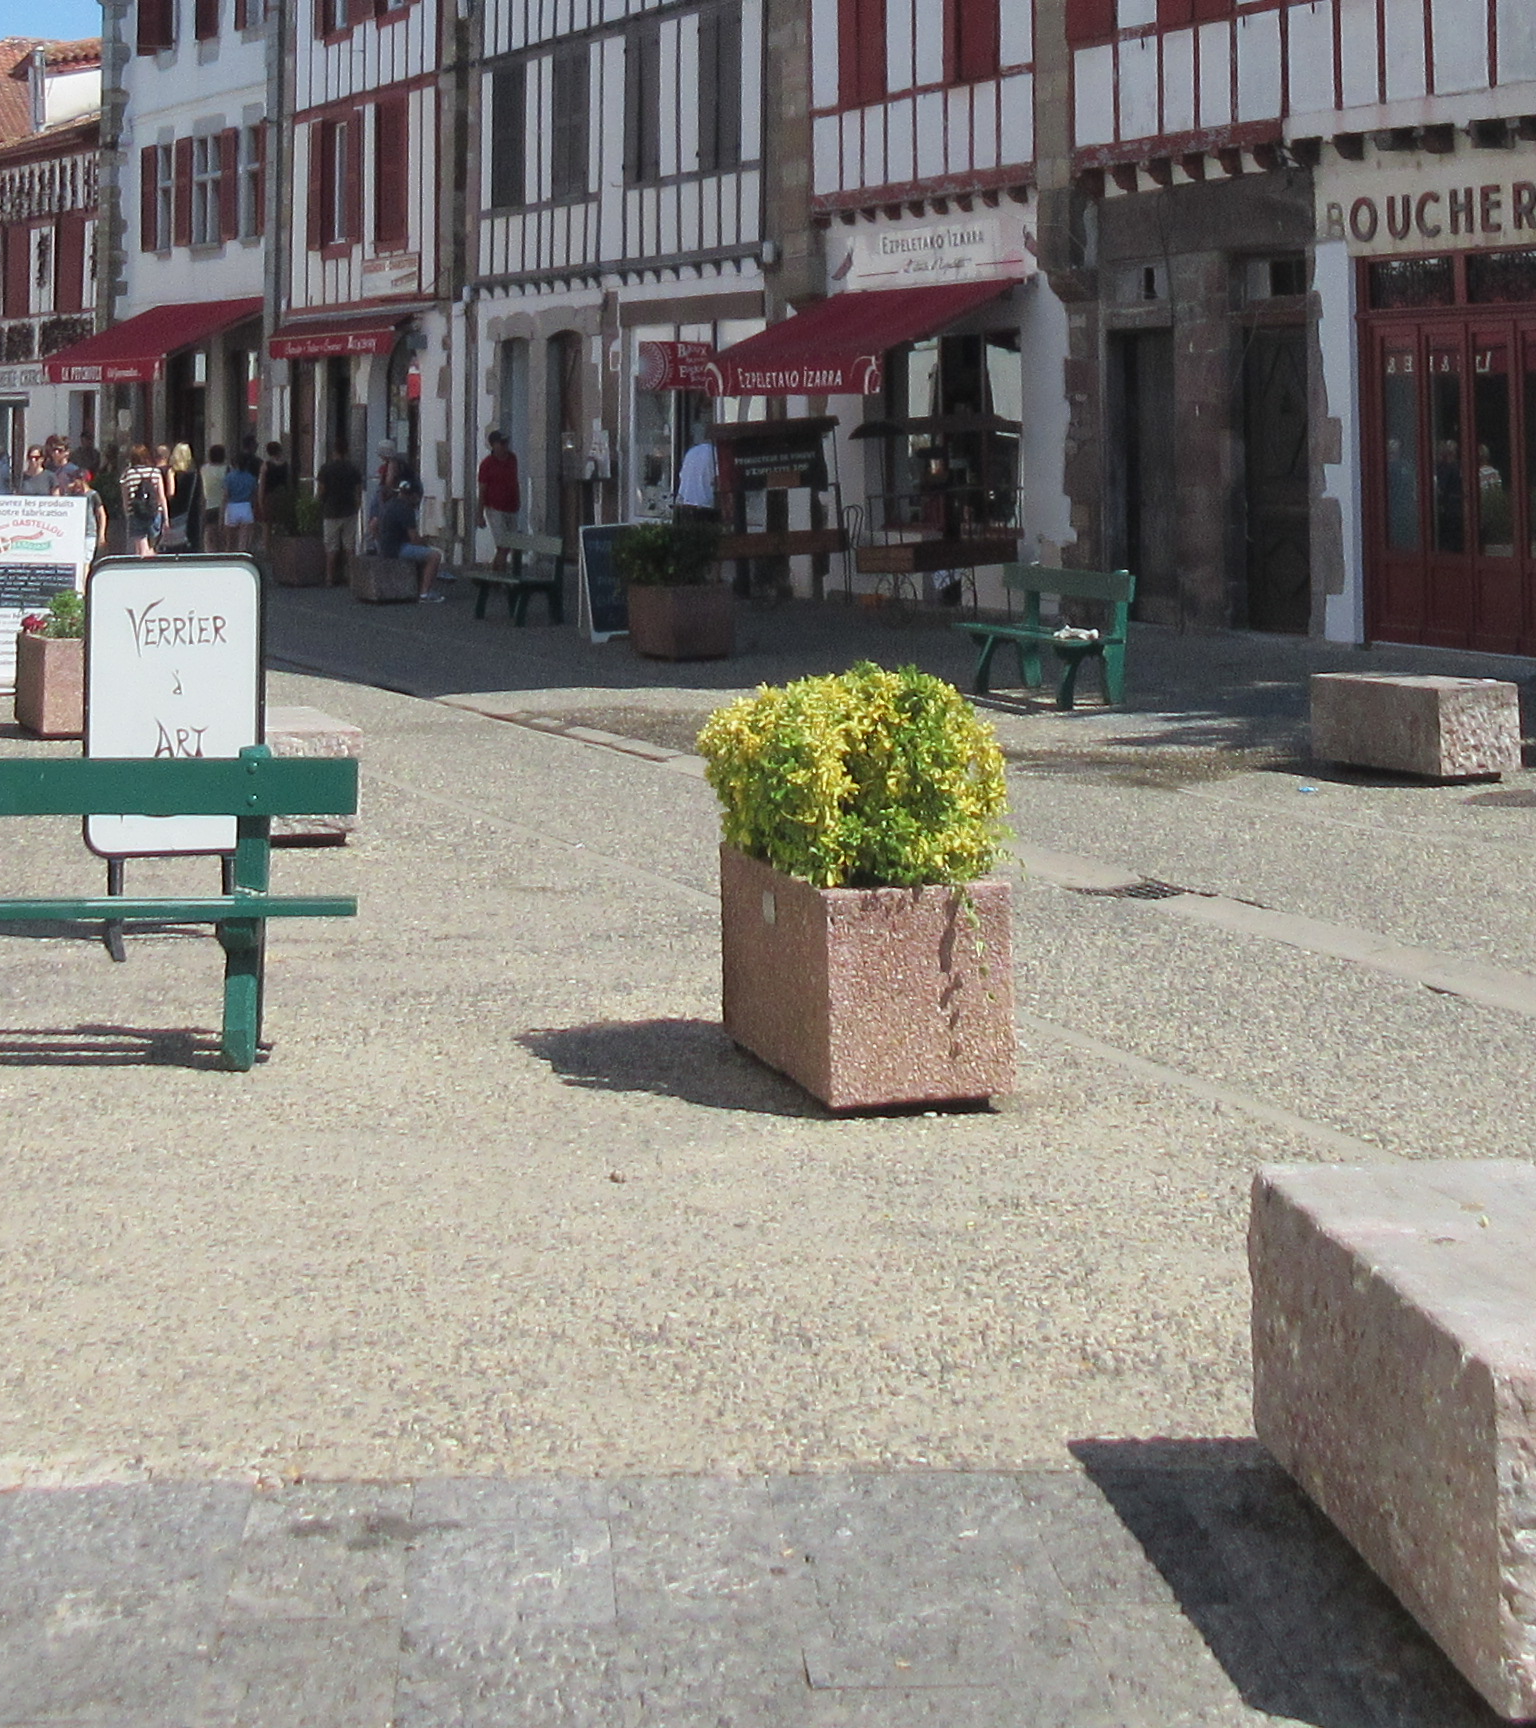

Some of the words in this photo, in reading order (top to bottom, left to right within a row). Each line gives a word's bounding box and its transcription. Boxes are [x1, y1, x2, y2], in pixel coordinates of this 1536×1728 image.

[882, 235, 944, 255] EZPELETAKO
[24, 498, 36, 507] les
[39, 498, 75, 508] produits
[21, 508, 69, 518] fabrication
[12, 519, 65, 538] GASTELLOU
[154, 717, 209, 758] ART
